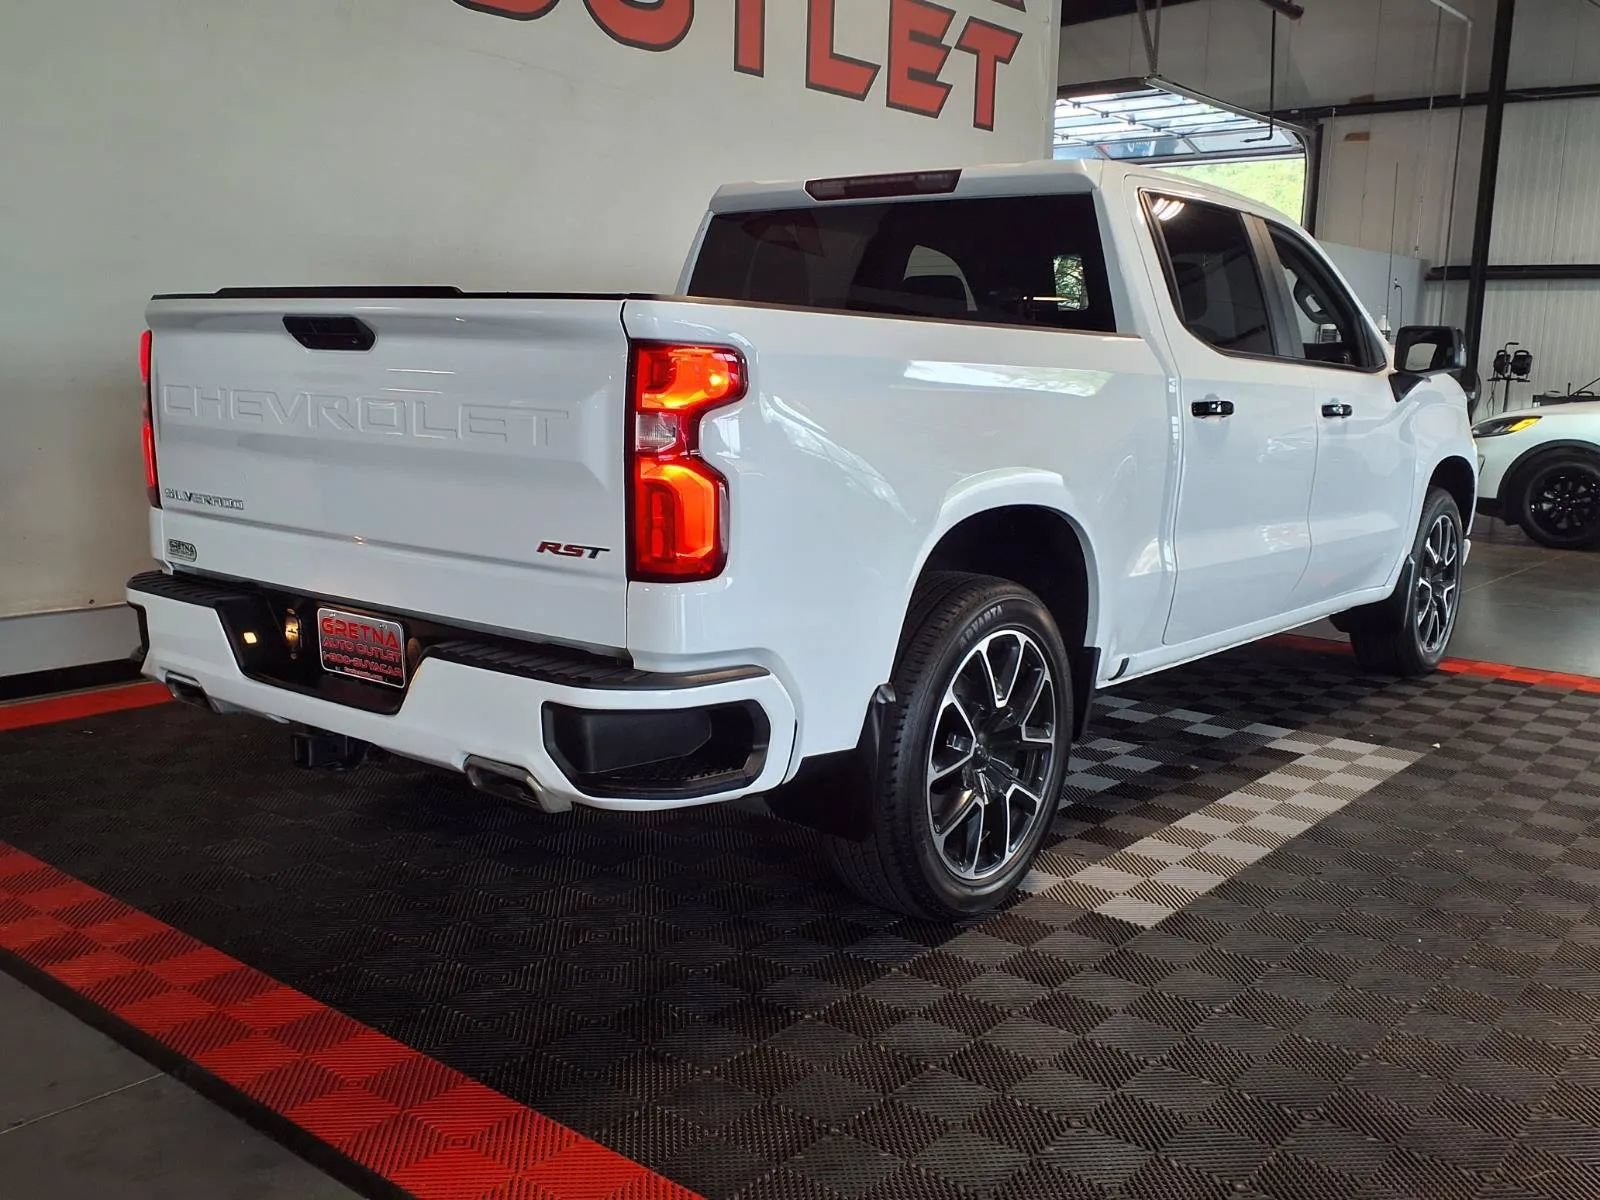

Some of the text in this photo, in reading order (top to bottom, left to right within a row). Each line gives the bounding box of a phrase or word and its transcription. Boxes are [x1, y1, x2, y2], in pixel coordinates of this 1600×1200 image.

[162, 383, 570, 447] CHEVROLET
[164, 488, 244, 510] SILVERADO
[536, 541, 611, 559] RST
[321, 617, 399, 649] GRETNA
[958, 605, 1003, 647] ADVANTA
[322, 636, 401, 663] AUTO OUTLET
